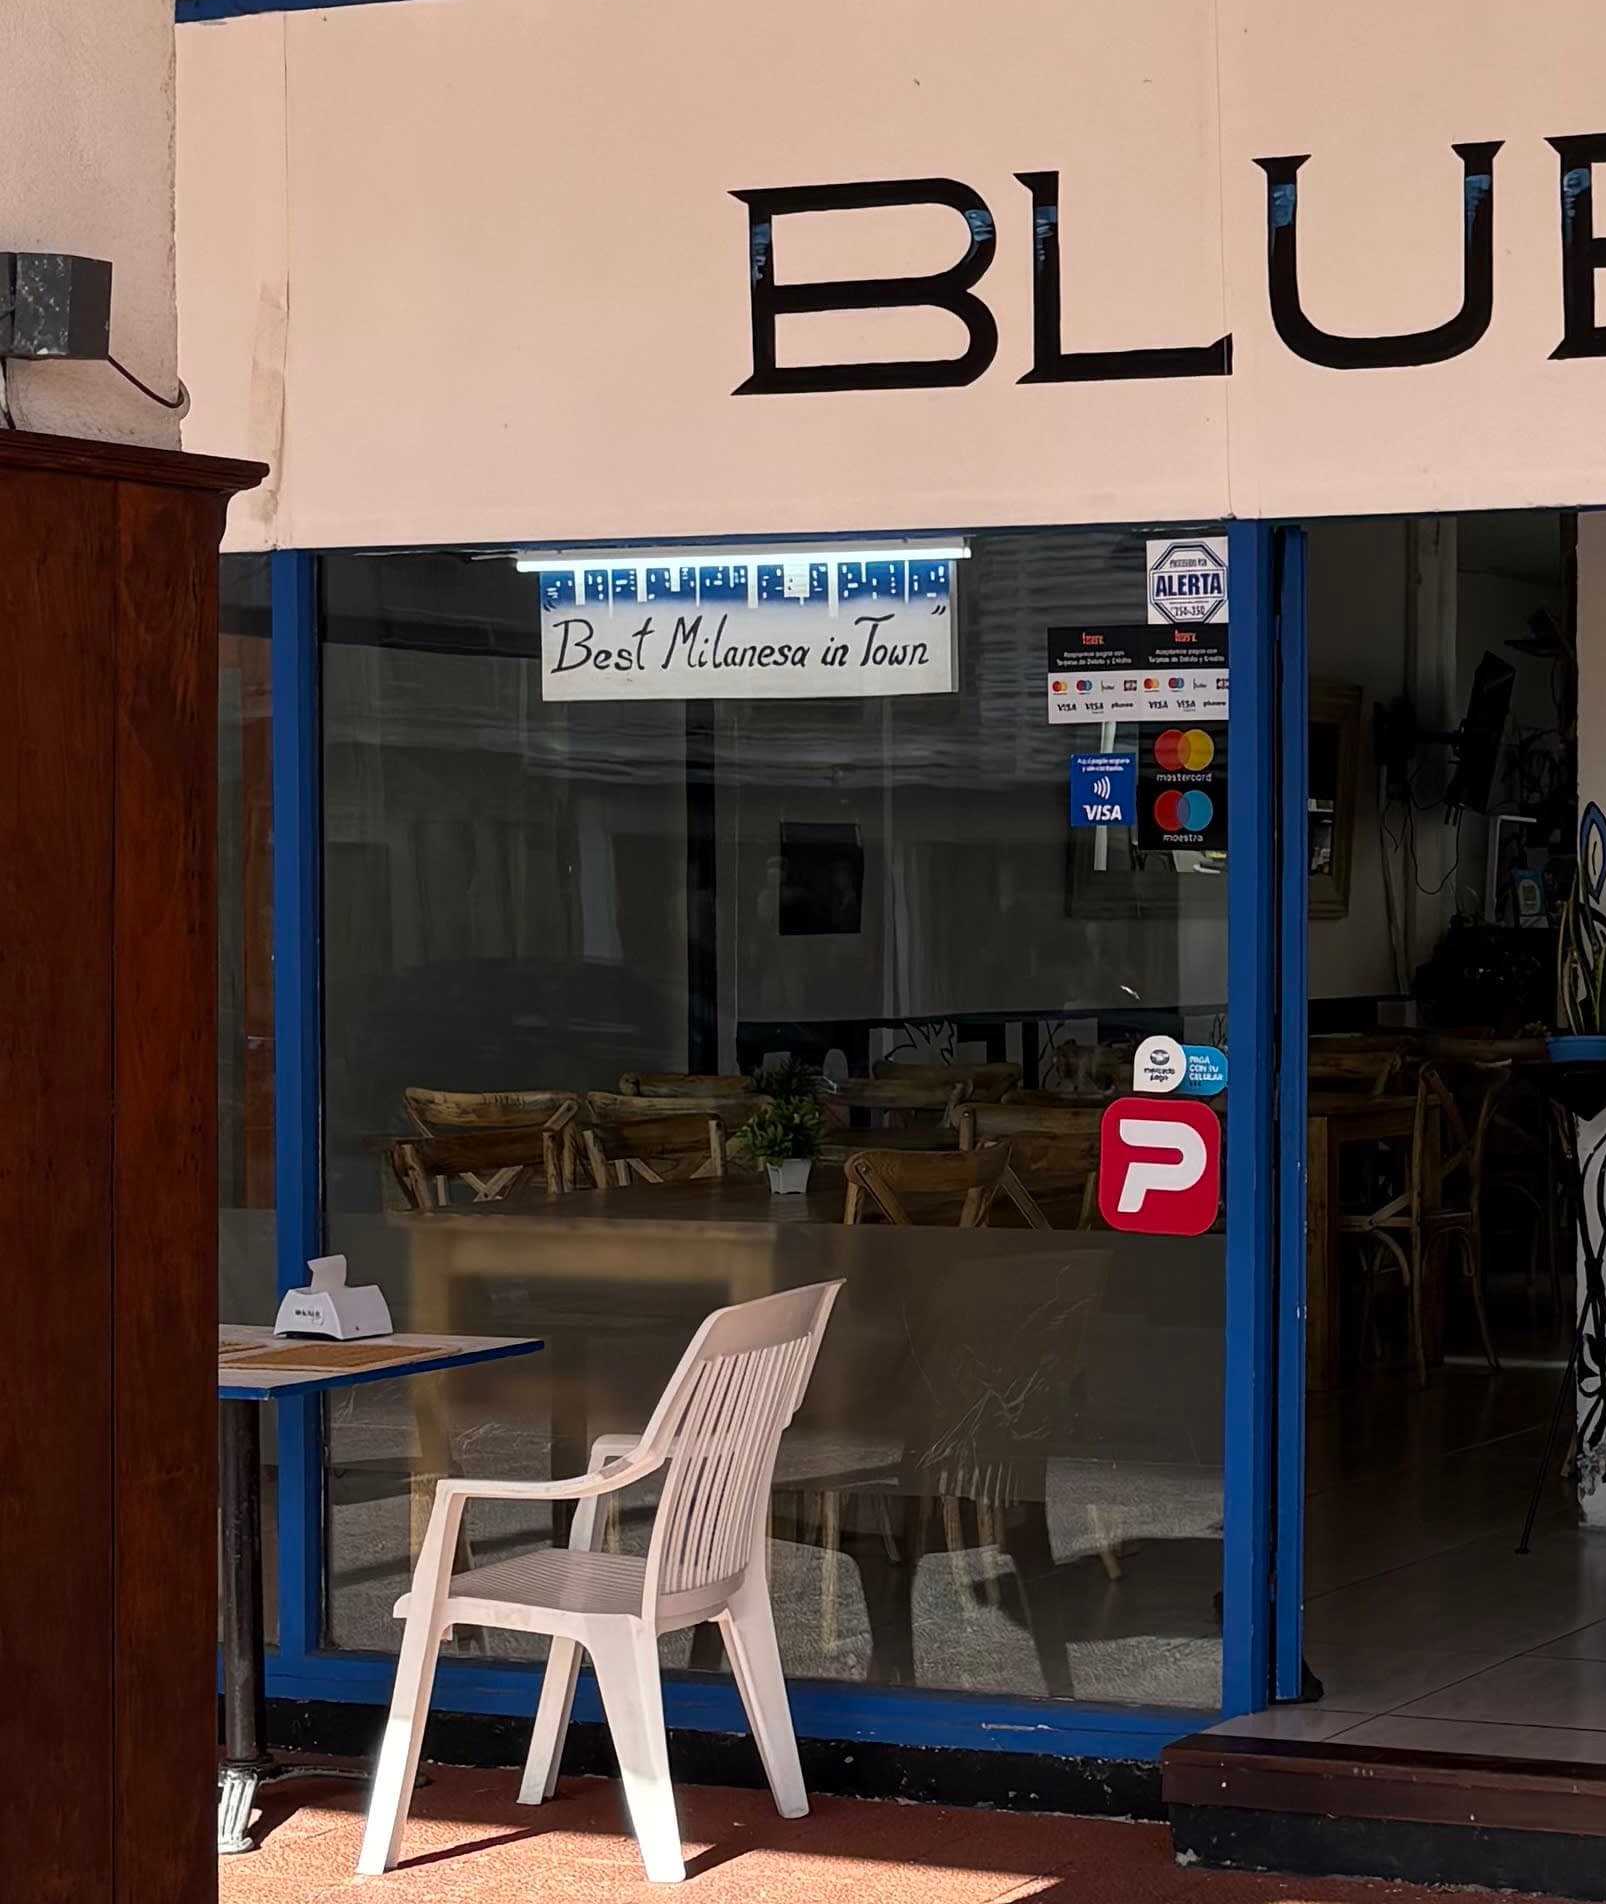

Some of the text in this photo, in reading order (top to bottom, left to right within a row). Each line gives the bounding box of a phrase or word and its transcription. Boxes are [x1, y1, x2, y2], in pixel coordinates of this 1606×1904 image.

[1155, 572, 1222, 597] ALERTA
[661, 613, 810, 670] Milanesa
[821, 636, 850, 668] in
[1057, 703, 1077, 712] VISA
[1085, 701, 1104, 711] VISA
[1148, 700, 1169, 709] VISA
[1176, 699, 1196, 708] VISA
[1156, 772, 1213, 783] mastercard
[1082, 804, 1122, 821] VISA
[1188, 1056, 1210, 1064] PAGA
[1188, 1064, 1206, 1073] CON
[1188, 1073, 1224, 1081] CELULAR
[1118, 1118, 1207, 1213] P
